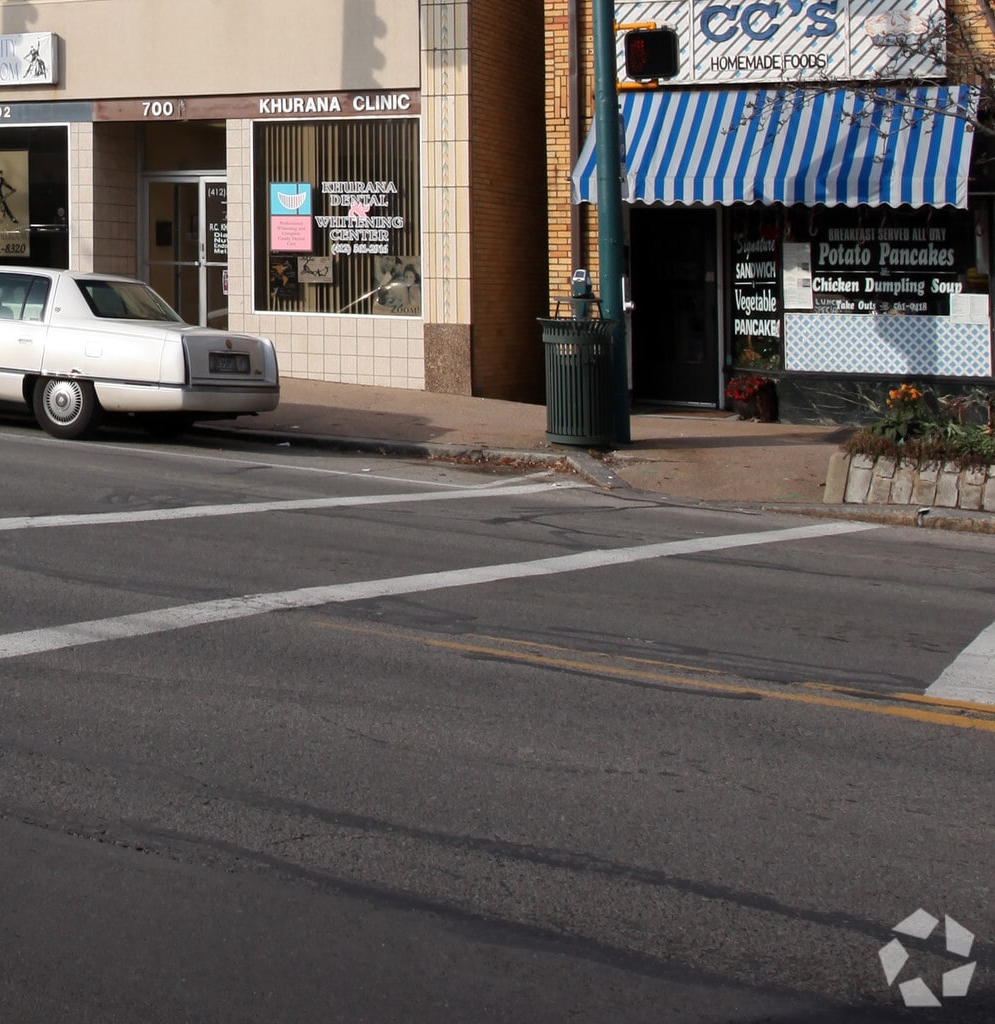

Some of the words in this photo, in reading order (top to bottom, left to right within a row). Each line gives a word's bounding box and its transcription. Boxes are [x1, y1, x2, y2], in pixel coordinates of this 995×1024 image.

[710, 54, 782, 72] HOMEMADE
[783, 53, 827, 69] FOODS
[142, 101, 173, 117] 700
[259, 96, 342, 113] KHURANA
[352, 94, 411, 111] CLINIC
[321, 181, 398, 194] KHURANA
[330, 194, 389, 207] DENTAL
[314, 216, 404, 229] WHITENING
[329, 229, 390, 242] CENTER
[828, 228, 875, 242] BREAKFAST
[877, 228, 910, 241] SERVED
[912, 228, 927, 241] ALL
[929, 228, 947, 241] DAY
[818, 242, 871, 266] Potato
[879, 242, 955, 266] Pancakes
[735, 261, 776, 279] SANDWICH
[812, 277, 860, 293] Chicken
[864, 278, 925, 296] Dumpling
[930, 278, 963, 294] Soup
[734, 289, 777, 316] Vegetable
[835, 299, 855, 310] Take
[857, 299, 876, 311] Outs
